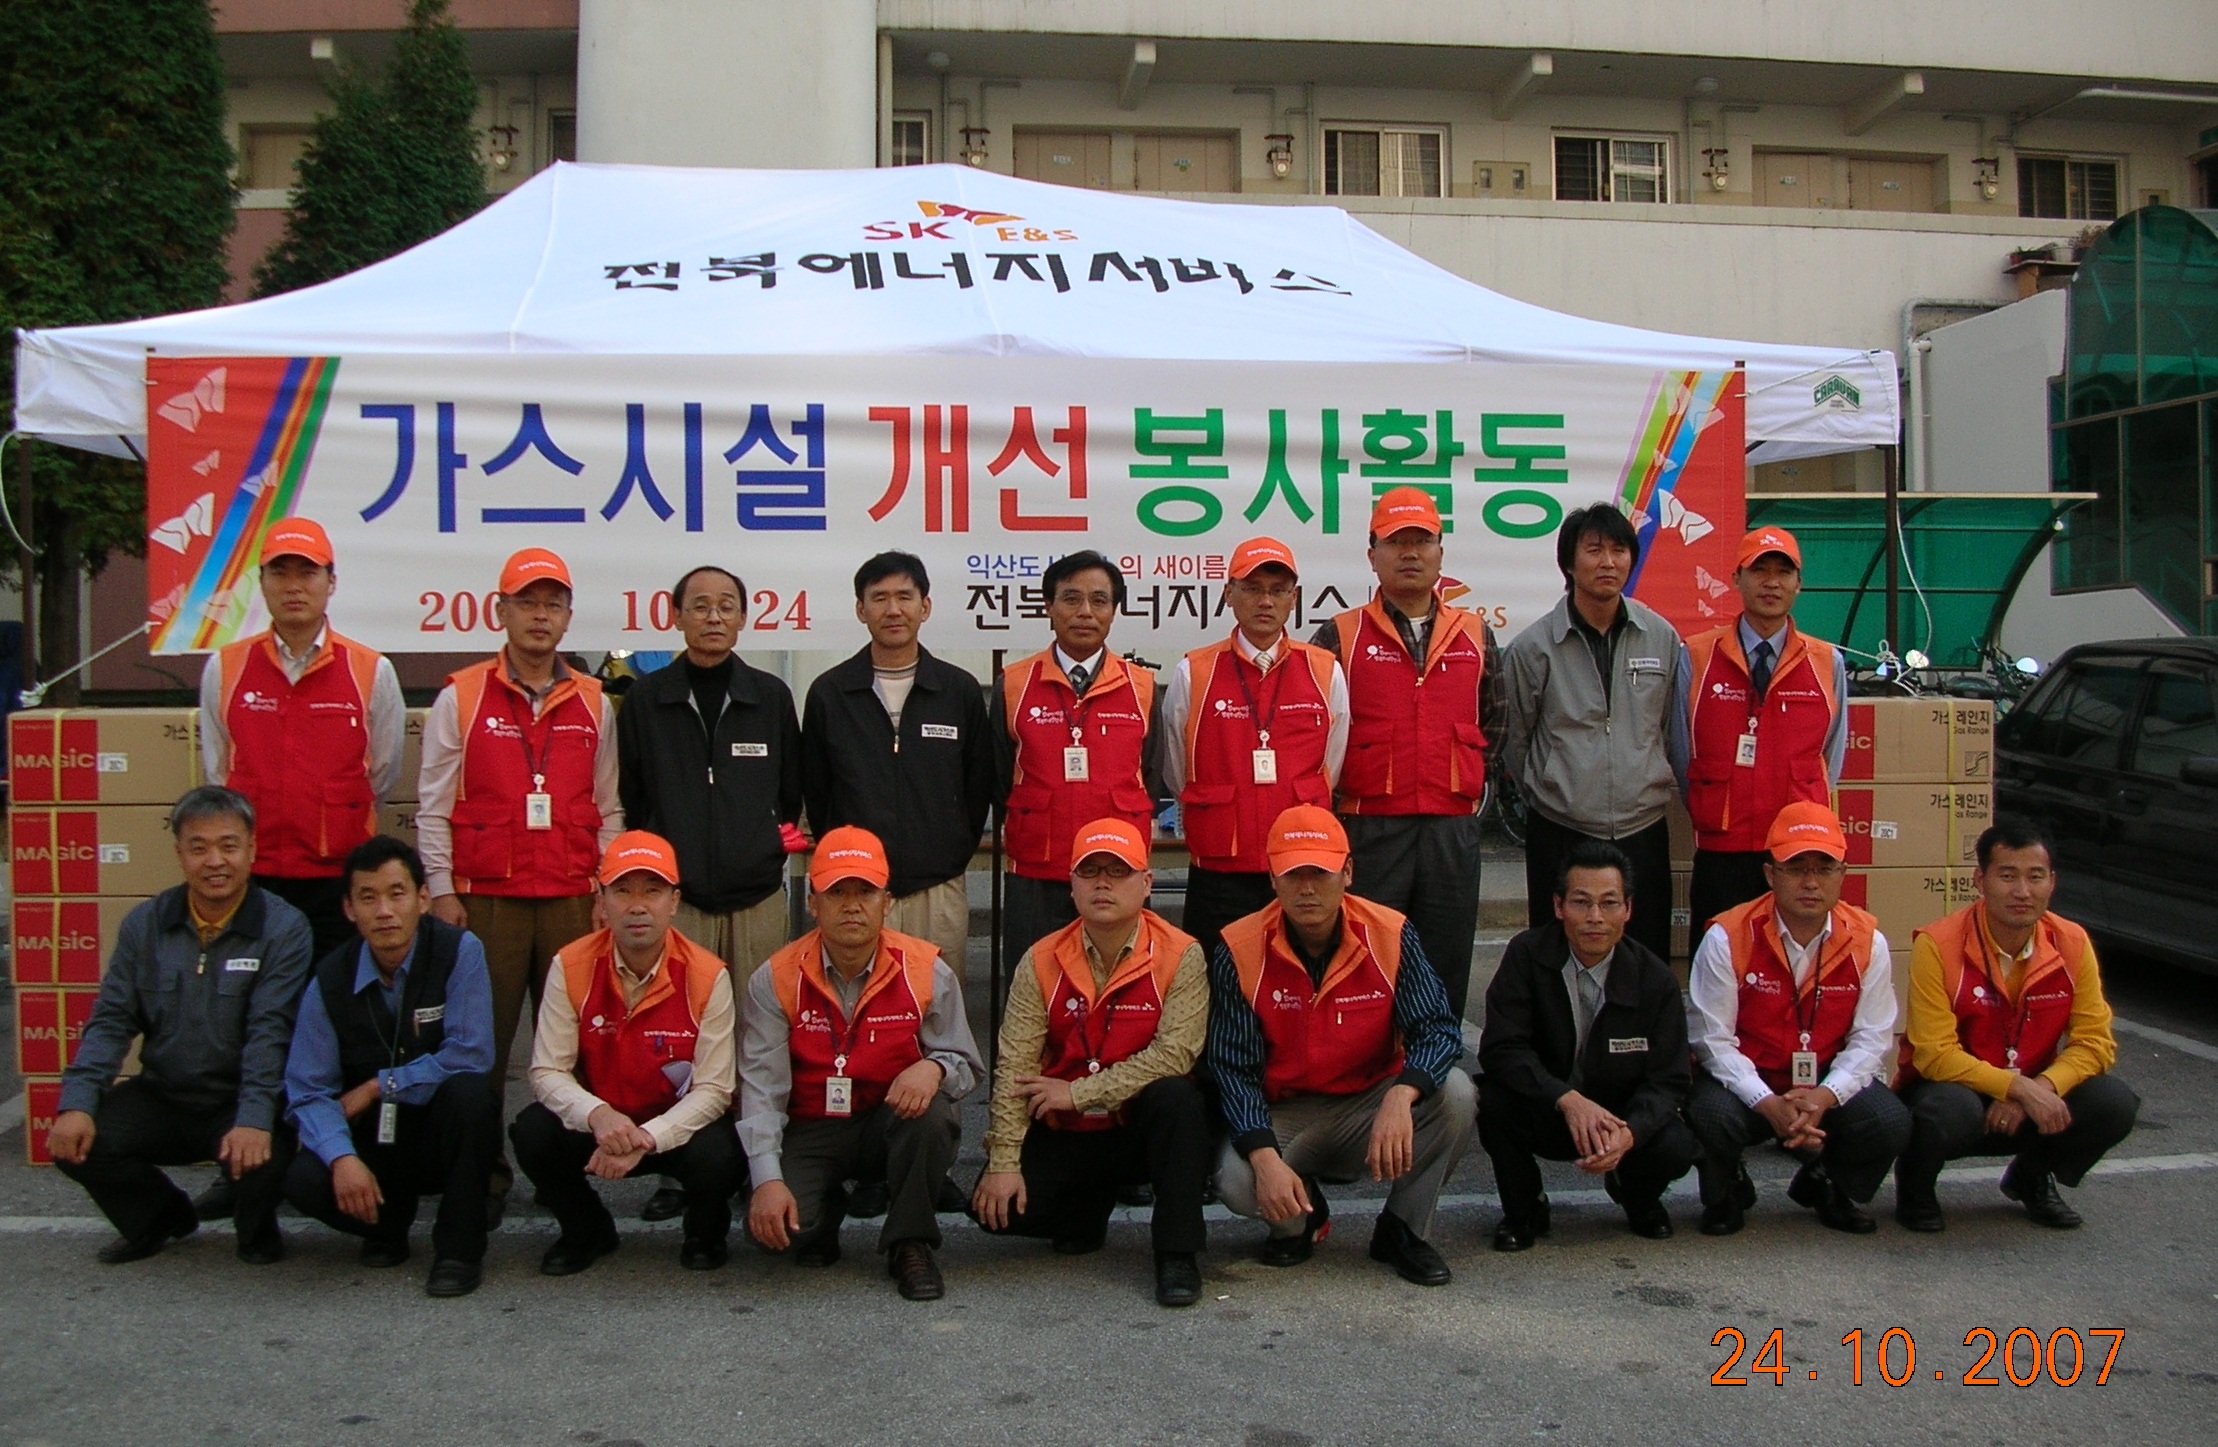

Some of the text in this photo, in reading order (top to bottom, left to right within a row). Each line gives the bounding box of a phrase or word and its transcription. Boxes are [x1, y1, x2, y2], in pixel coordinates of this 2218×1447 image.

[863, 221, 1079, 242] SK E&S
[359, 402, 1569, 540] 가스시설 개선 봉사활동
[1152, 554, 1228, 580] 새이름
[753, 590, 812, 632] 24
